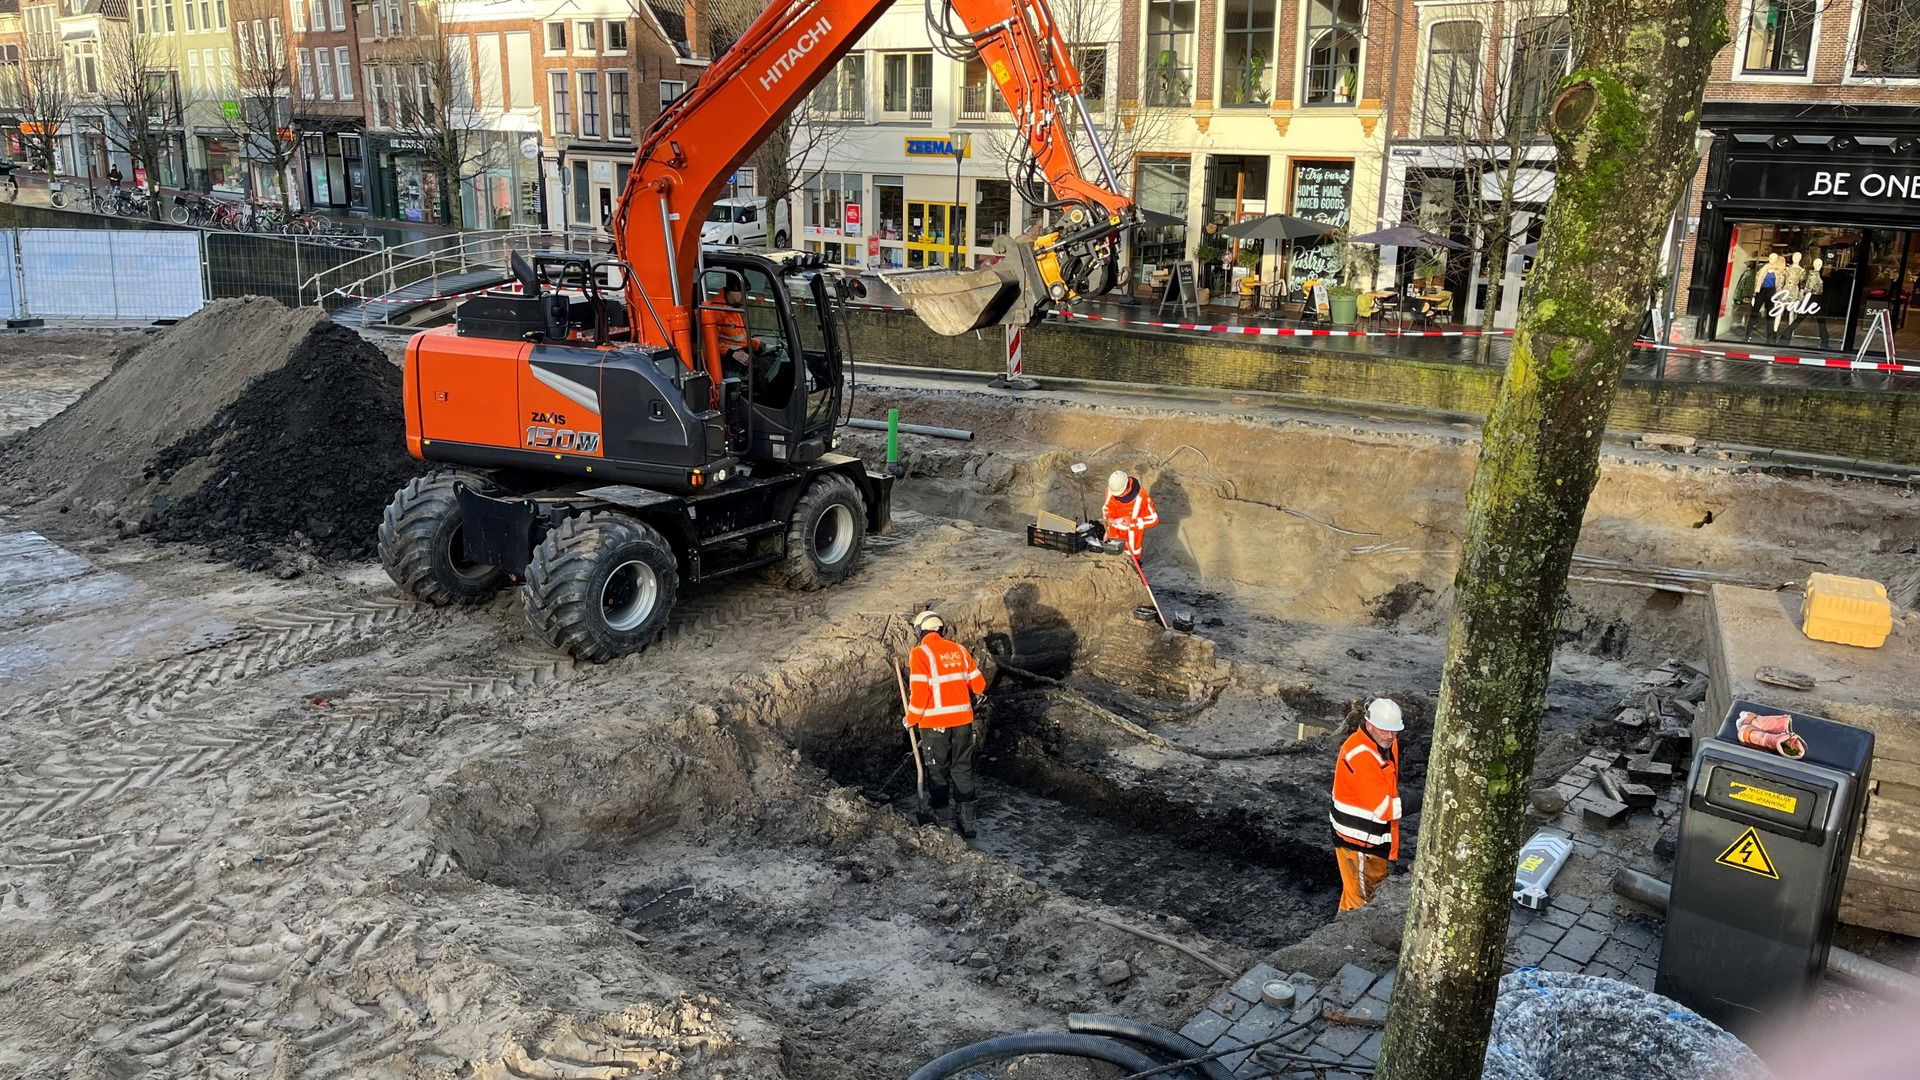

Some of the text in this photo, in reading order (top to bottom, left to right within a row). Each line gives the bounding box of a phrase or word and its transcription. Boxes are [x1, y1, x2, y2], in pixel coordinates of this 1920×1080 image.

[759, 16, 832, 92] HITACHI
[906, 140, 959, 155] ZEEMA
[1297, 185, 1344, 198] HOME MADE
[1807, 171, 1920, 199] BE ONE
[1321, 198, 1345, 209] GOODS
[1768, 289, 1821, 317] Sale
[531, 411, 566, 425] ZAXIS
[526, 425, 600, 453] 150W
